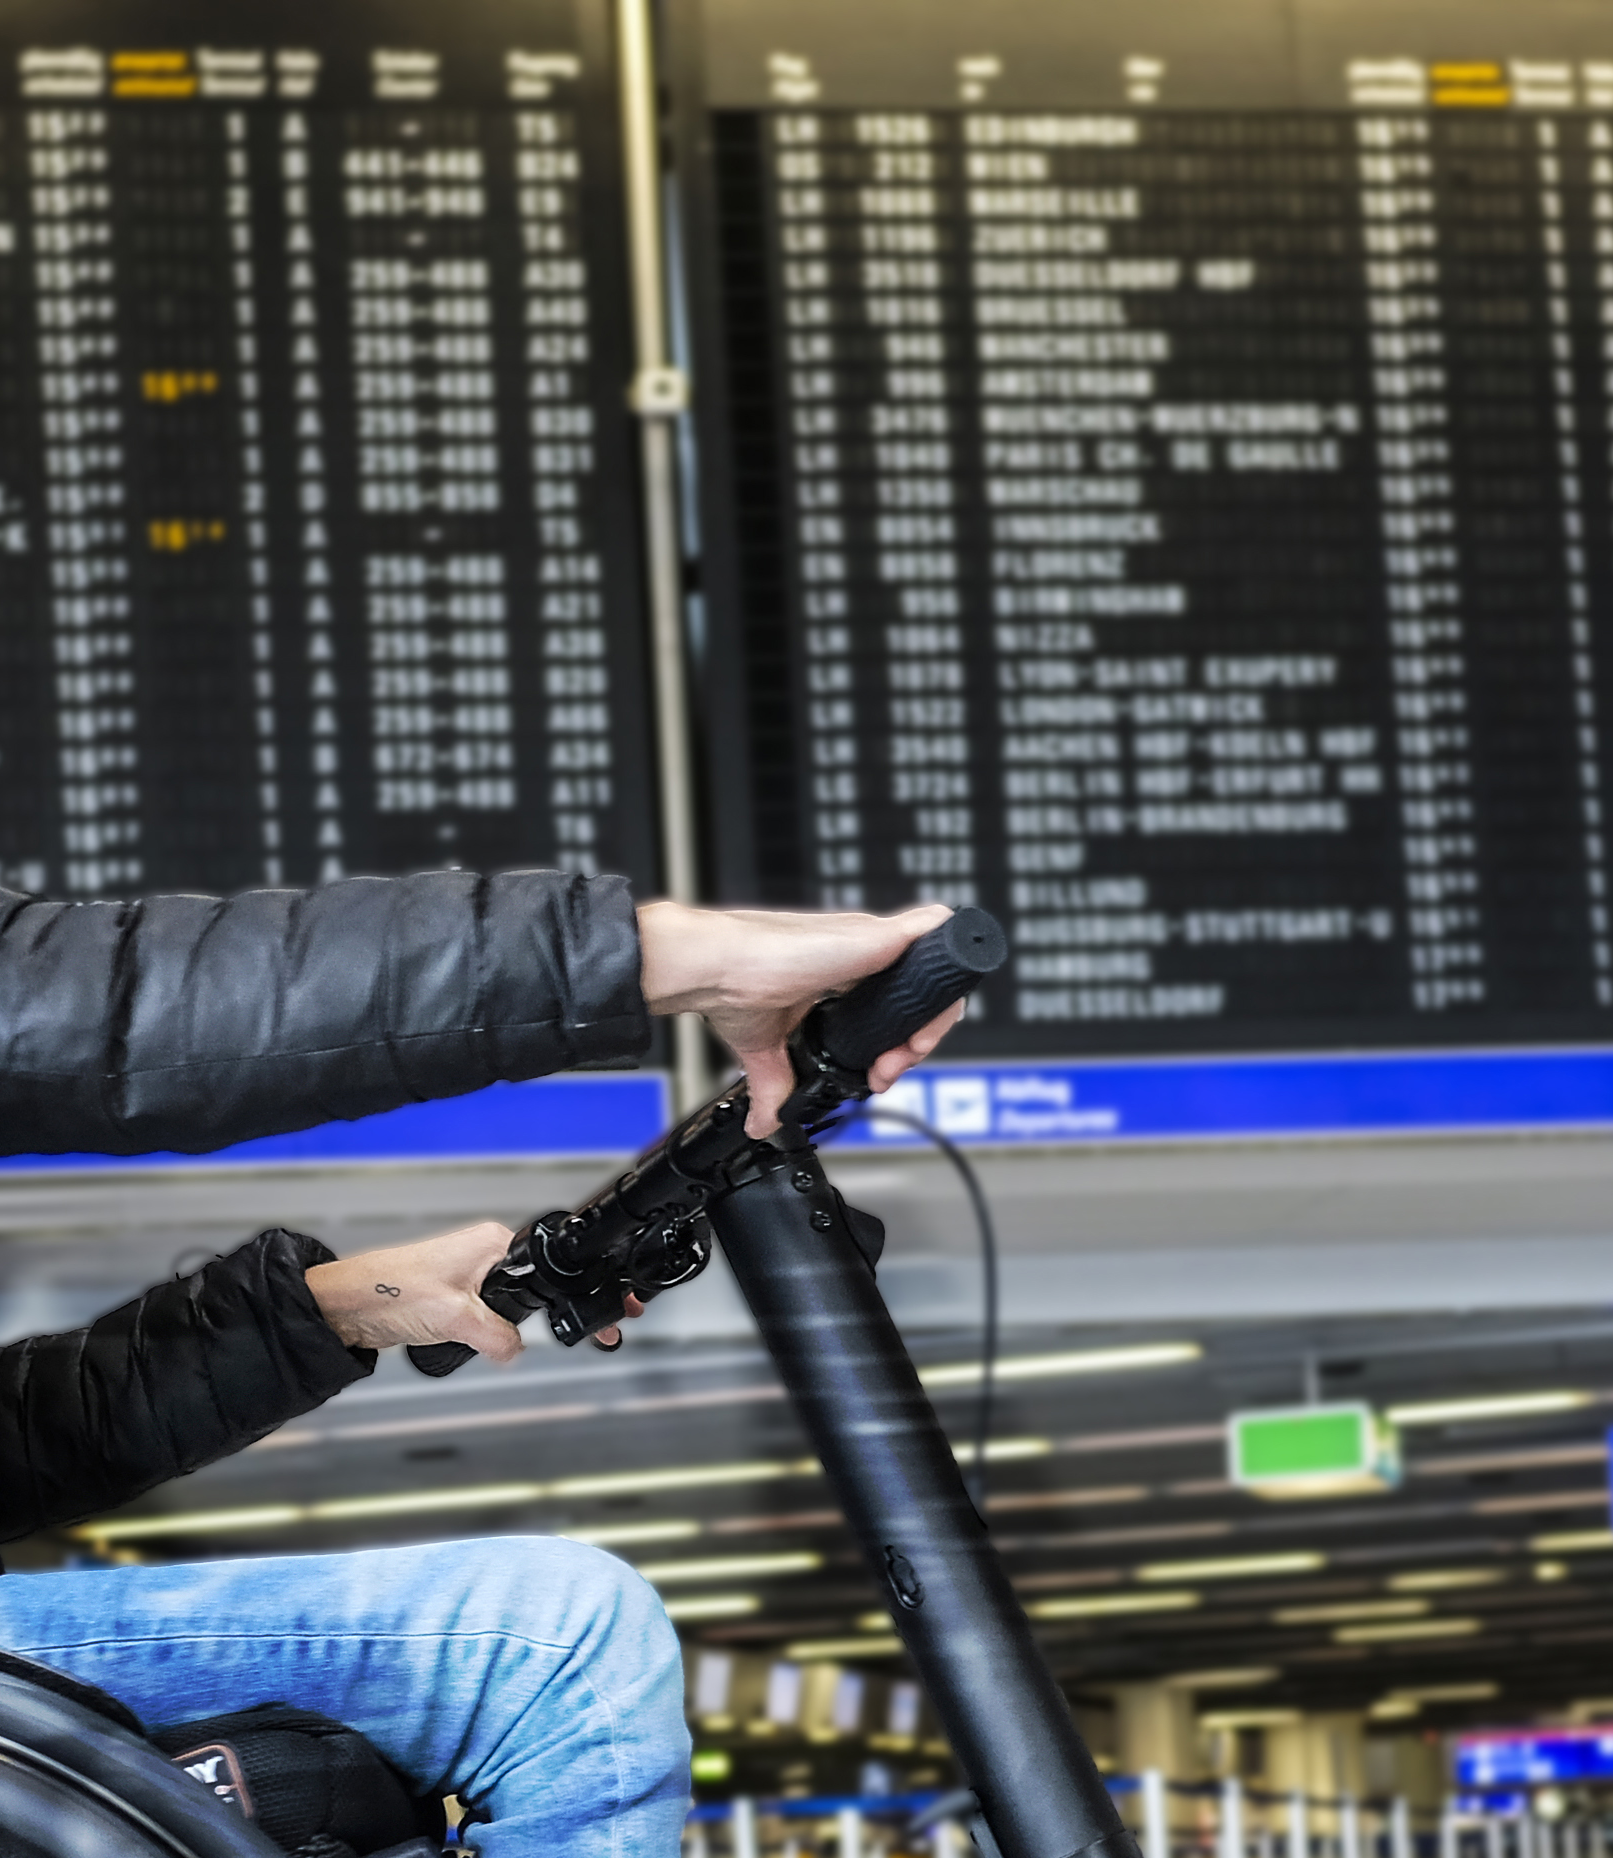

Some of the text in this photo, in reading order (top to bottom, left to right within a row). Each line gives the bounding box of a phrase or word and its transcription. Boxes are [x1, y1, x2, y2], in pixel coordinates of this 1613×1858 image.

[966, 116, 1137, 145] EDINBURGH
[969, 188, 1137, 217] MARSEILLE
[975, 224, 1106, 252] ZUERICH
[975, 260, 1179, 288] DUESSELDORF
[977, 297, 1124, 325] BRUESSEL
[979, 333, 1168, 361] MANCHESTER
[983, 369, 1152, 397] AMSTERDAM
[985, 442, 1081, 469] PARIS
[1227, 440, 1338, 469] GAULLE
[994, 550, 1123, 578] FLORENZ
[996, 623, 1093, 652] NIZZA
[1205, 657, 1335, 686] EXUPERY
[1002, 695, 1262, 724] LONDON-GATWICK
[1004, 733, 1119, 761] AACHEN
[1005, 770, 1121, 799] BERLIN
[1018, 986, 1222, 1019] DUESSELDORF
